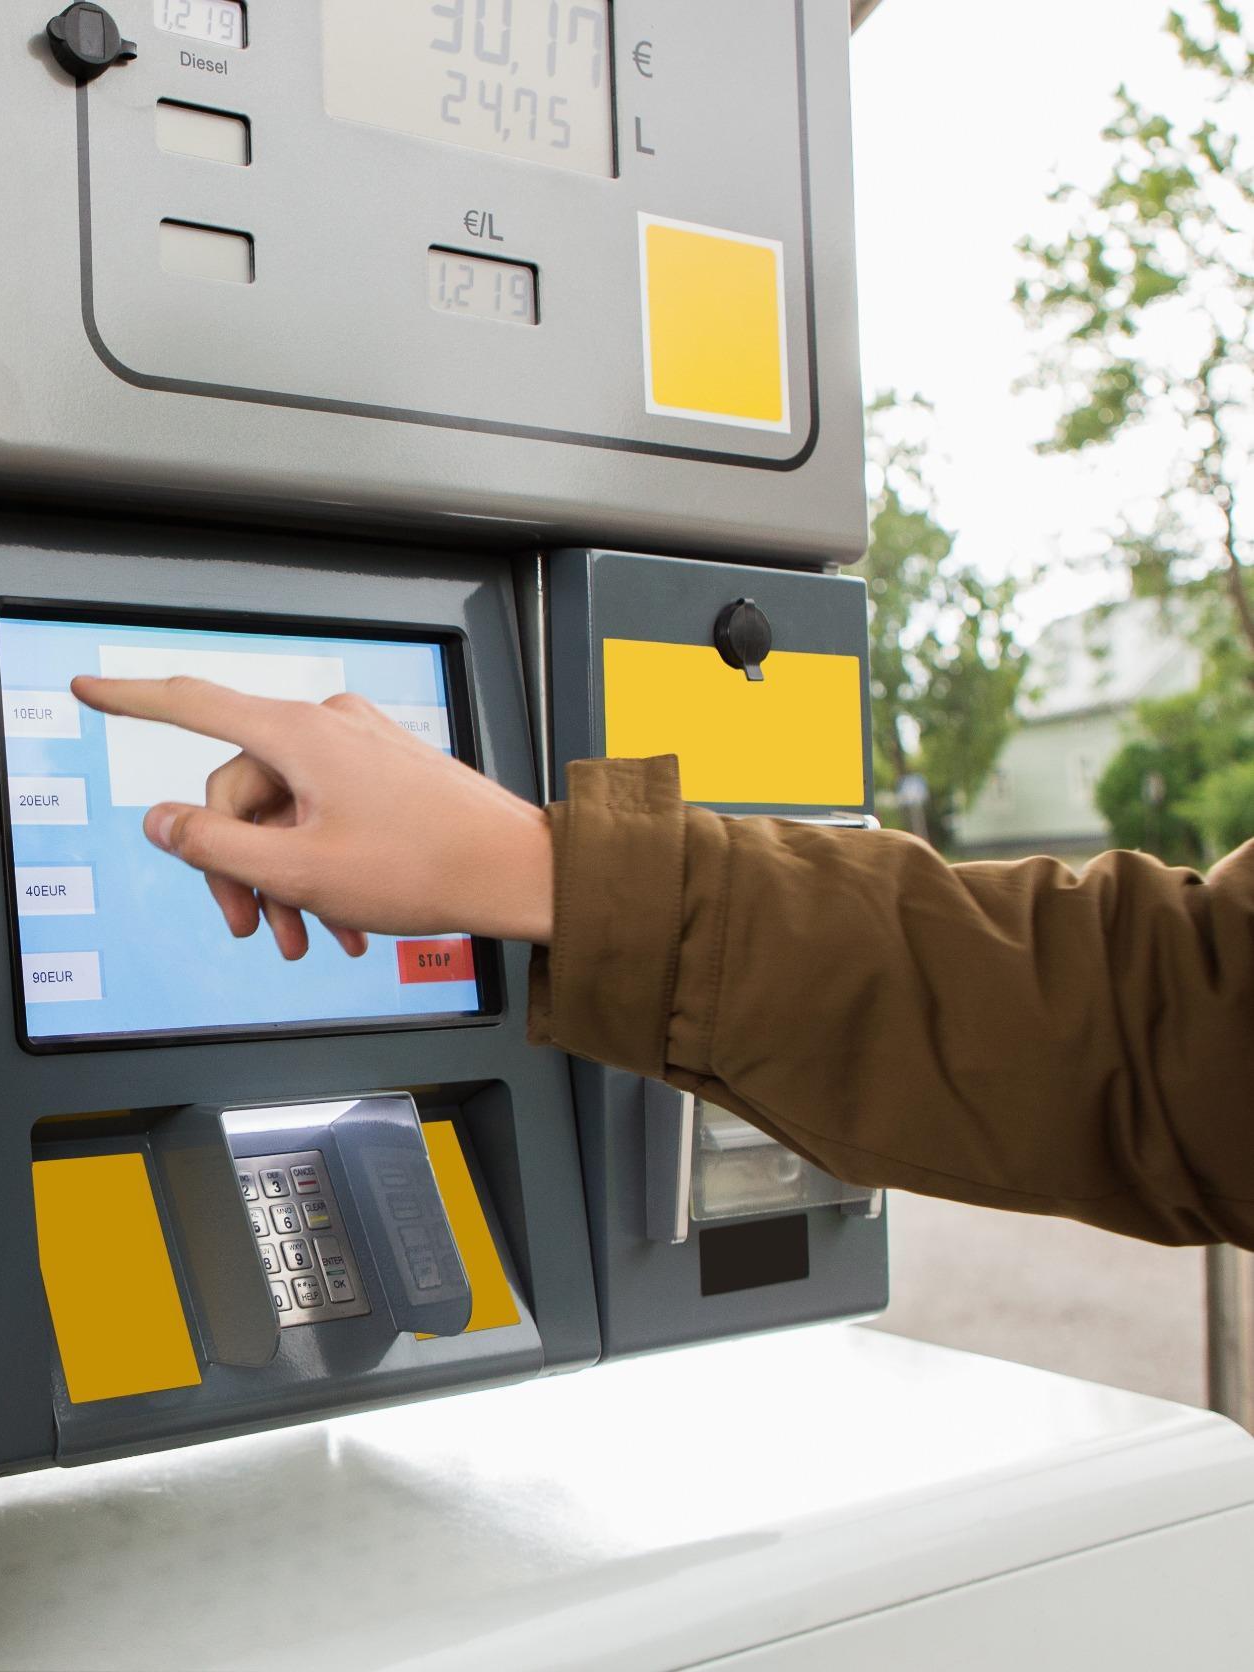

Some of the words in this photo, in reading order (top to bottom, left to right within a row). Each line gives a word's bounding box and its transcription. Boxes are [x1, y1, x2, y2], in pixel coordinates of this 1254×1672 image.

[180, 51, 227, 75] Diesel
[632, 40, 653, 78] €
[441, 70, 570, 149] 24,75
[634, 116, 655, 155] L
[463, 210, 504, 241] €/L
[439, 261, 529, 316] 1,219
[13, 708, 53, 720] 10EUR
[19, 795, 60, 807] 20EUR
[25, 885, 67, 897] 40EUR
[418, 953, 450, 968] STOP
[32, 971, 73, 983] 90EUR
[293, 1167, 315, 1177] CANCEL
[242, 1185, 250, 1196] 2
[272, 1181, 281, 1193] 3
[305, 1202, 326, 1212] CLEAR
[252, 1221, 260, 1233] 5
[284, 1217, 292, 1229] 6
[263, 1257, 272, 1269] 8
[295, 1253, 303, 1266] 9
[321, 1256, 345, 1266] ENTER
[334, 1280, 346, 1289] OK
[274, 1295, 283, 1307] 0
[301, 1291, 319, 1301] HELP
